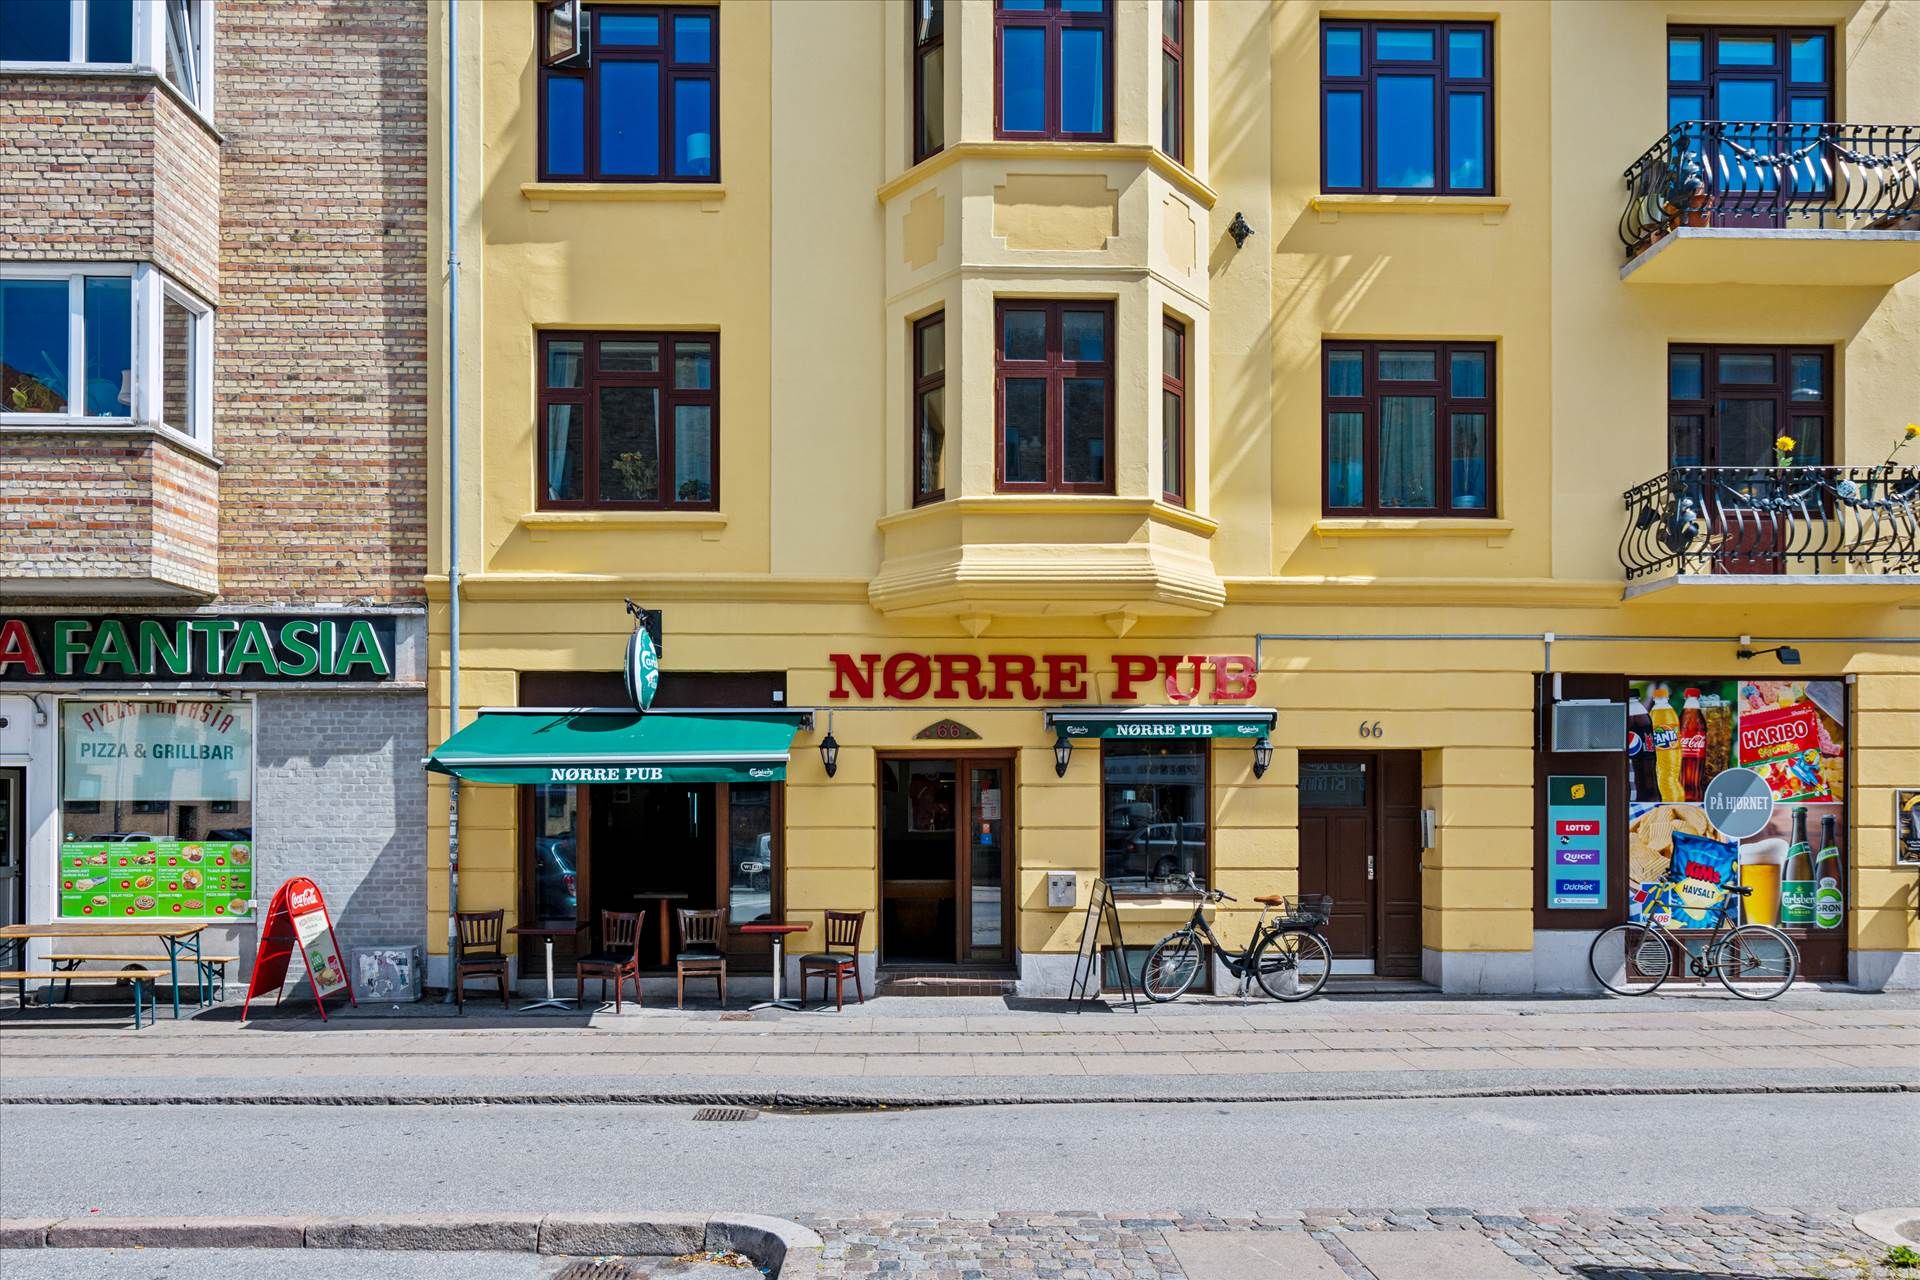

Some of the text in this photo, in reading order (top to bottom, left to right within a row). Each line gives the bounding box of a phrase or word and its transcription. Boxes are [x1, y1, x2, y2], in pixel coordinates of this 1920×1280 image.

[54, 620, 389, 676] FANTASIA
[829, 652, 1257, 701] NØRRE PUB
[937, 724, 960, 737] 66
[1116, 724, 1176, 735] NØRRE
[1179, 724, 1213, 735] PUB
[1360, 720, 1383, 738] 66
[1743, 720, 1809, 749] HARIBO
[81, 743, 234, 760] PIZZA & GRILLBAR
[551, 768, 620, 781] NØRRE
[625, 767, 663, 780] PUB
[1710, 792, 1769, 813] PÅ HJØRNET
[1565, 824, 1592, 832] LOTTO
[1563, 853, 1592, 862] QUICK
[1682, 884, 1716, 899] HAVSALT
[1782, 891, 1815, 907] Carlsber
